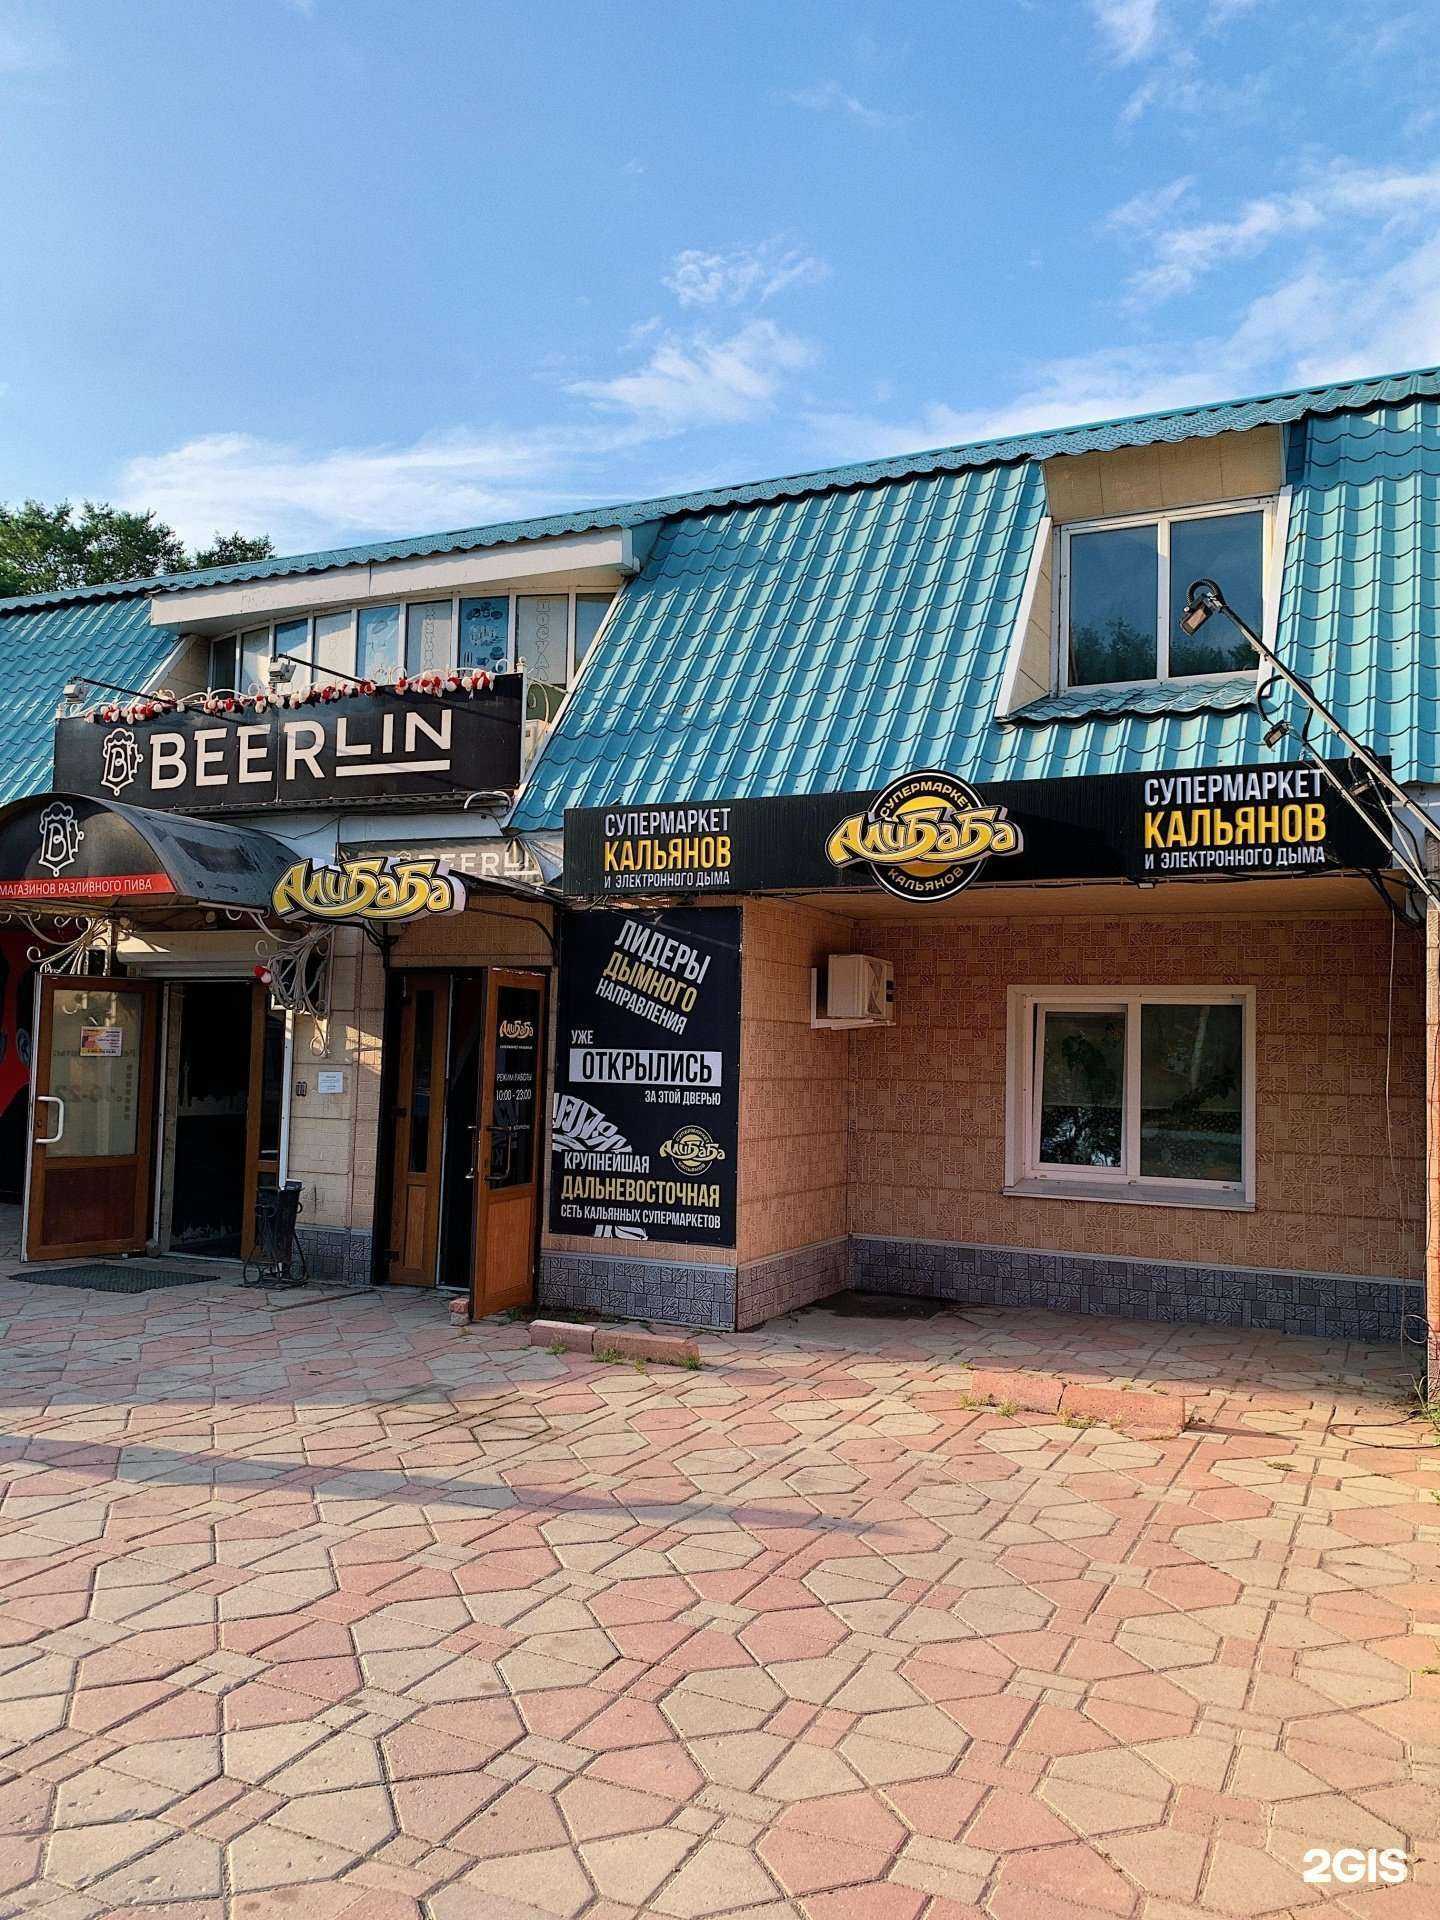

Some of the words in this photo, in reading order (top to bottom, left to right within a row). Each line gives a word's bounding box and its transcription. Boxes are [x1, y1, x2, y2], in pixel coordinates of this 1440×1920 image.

[150, 709, 452, 790] BEERLIN
[1144, 768, 1325, 807] СУПЕРМАРКЕТ
[605, 807, 732, 837] СУПЕРМАРКЕТ
[1144, 803, 1327, 849] КАЛЬЯНОВ
[604, 836, 732, 872] КАЛЬЯНОВ
[1144, 853, 1154, 870] И
[1160, 848, 1272, 869] ЭЛЕКТРОННОГО
[1276, 846, 1326, 866] ДЫМА
[58, 880, 121, 894] РАЗЛИВНОГО
[124, 878, 152, 891] ПИВА
[604, 875, 611, 889] И
[615, 872, 694, 888] ЭЛЕКТРОННОГО
[696, 871, 730, 887] ДЫМА
[887, 866, 965, 892] КАЛЬЯНОВ
[614, 919, 711, 984] ЛИДЕРЫ
[602, 951, 698, 1013] ДЫМНОГО
[595, 977, 688, 1035] НАПРАВЛЕНИЯ
[571, 1029, 594, 1045] УЖЕ
[582, 1050, 713, 1083] ОТКРЫЛИСЬ
[645, 1090, 657, 1103] ЗА
[658, 1088, 681, 1104] ЭТОЙ
[682, 1091, 721, 1106] ДВЕРЬЮ
[560, 1175, 720, 1208] ДАЛЬНЕВОСТОЧНАЯ
[560, 1204, 582, 1219] СЕТЬ
[584, 1205, 641, 1223] КАЛЬЯННЫХ
[642, 1209, 721, 1229] СУПЕРМАРКЕТОВ
